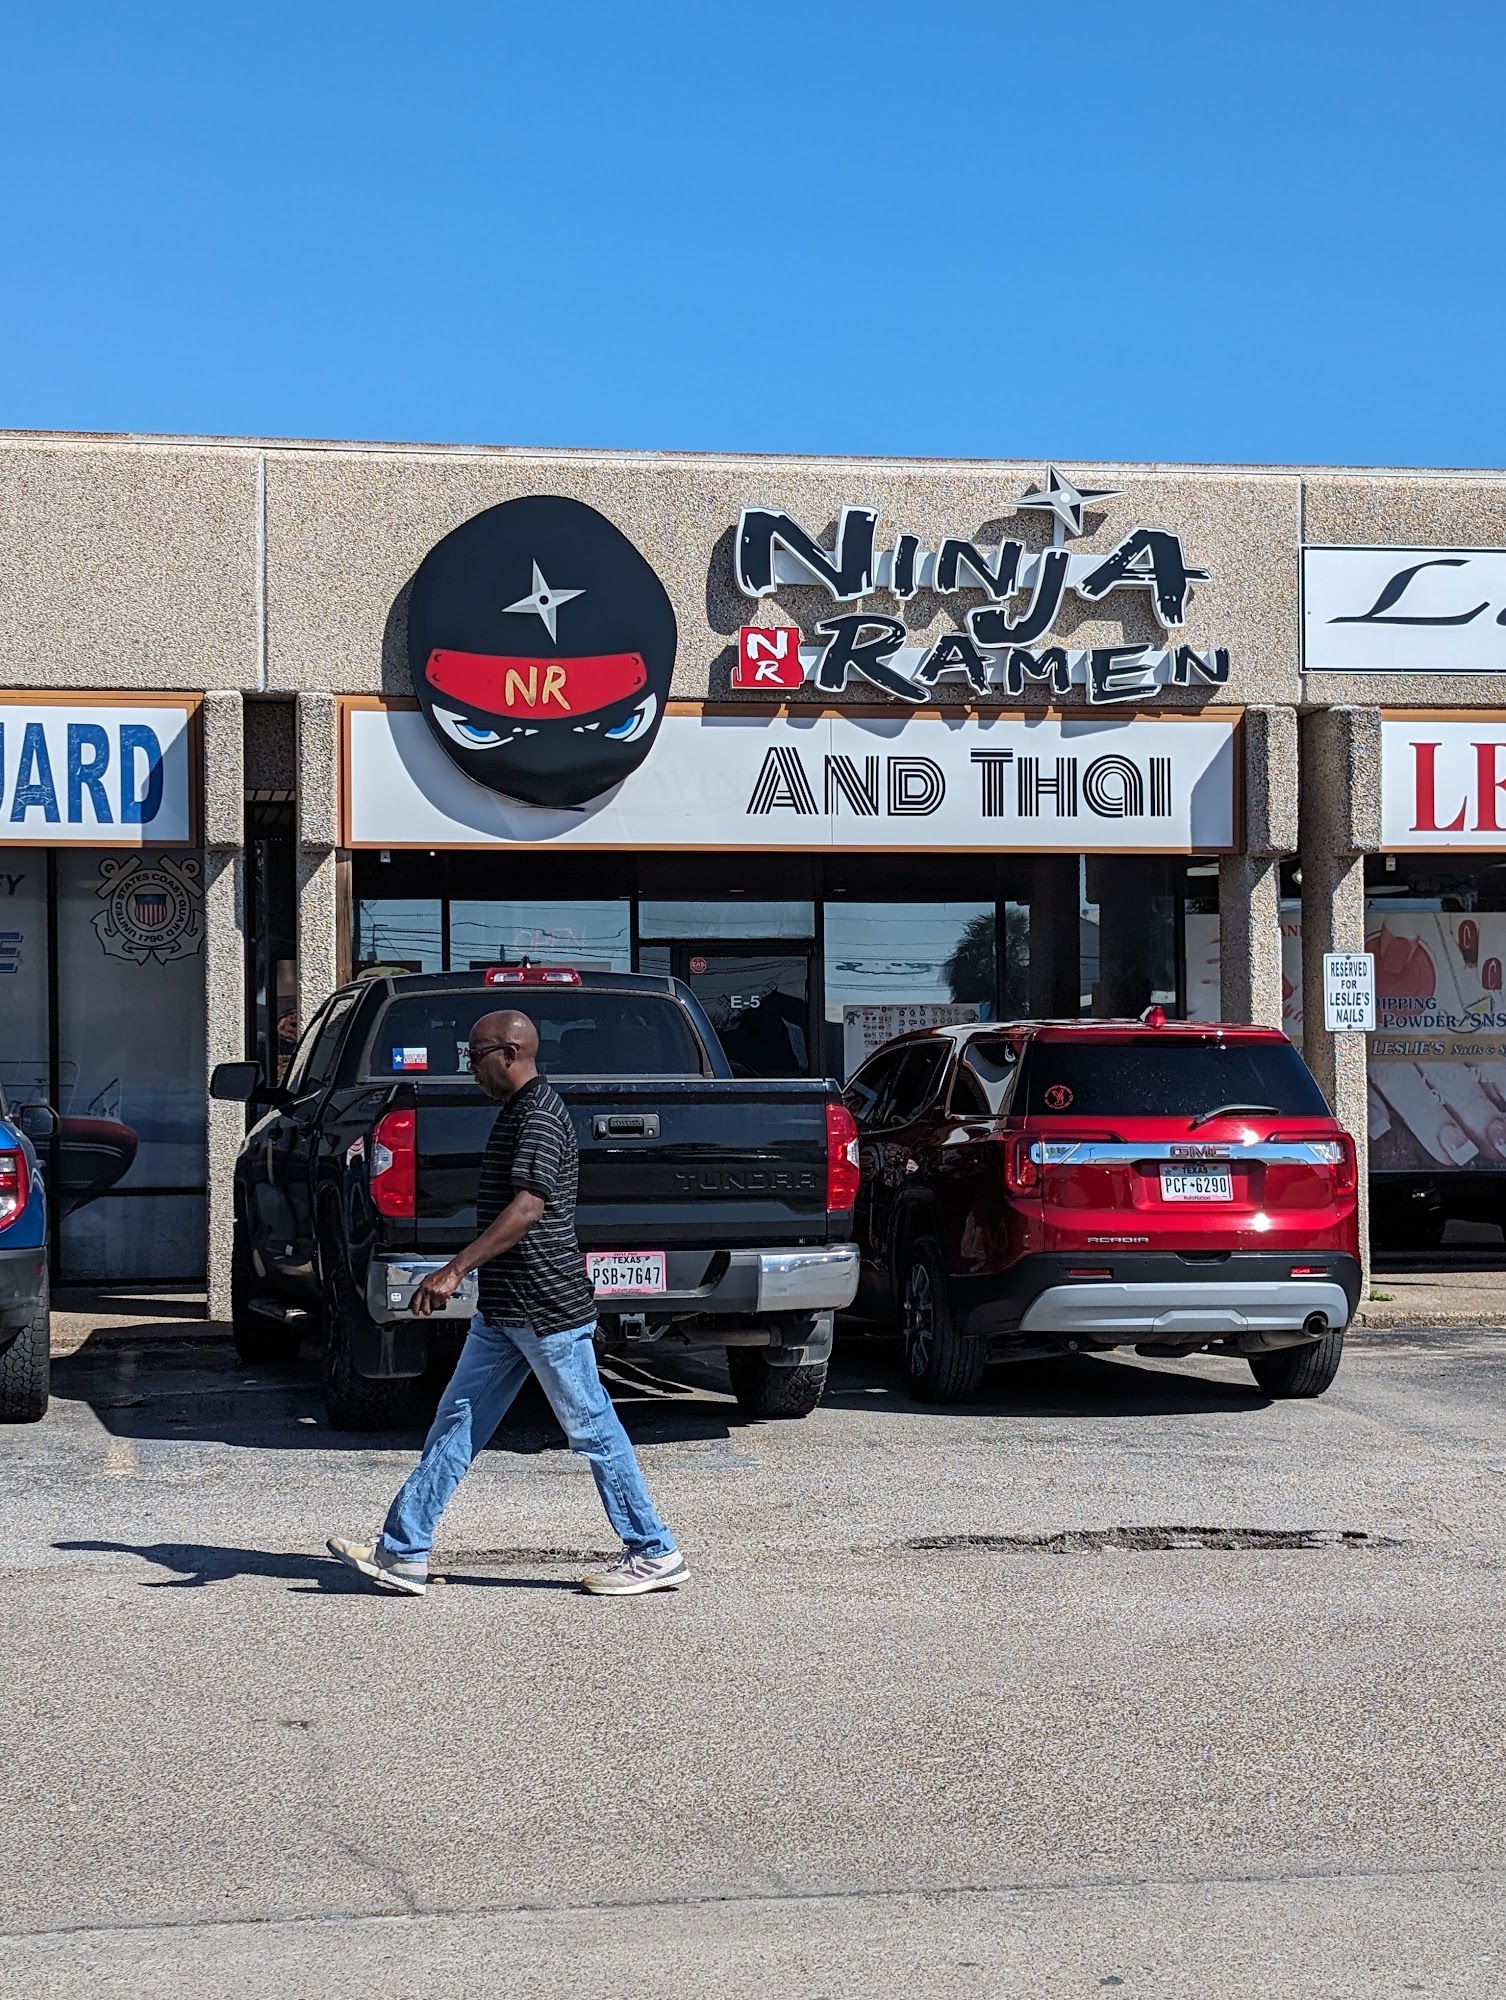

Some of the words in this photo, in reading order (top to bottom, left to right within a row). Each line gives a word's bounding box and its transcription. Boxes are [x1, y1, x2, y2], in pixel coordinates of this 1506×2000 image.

[735, 505, 1212, 648] NINJA
[1325, 559, 1506, 626] L
[814, 612, 1231, 704] RAMEN
[505, 665, 571, 711] NR
[0, 722, 164, 824] ARD
[746, 746, 946, 817] AND
[117, 873, 150, 901] STATES
[151, 873, 185, 899] COAST
[115, 901, 137, 938] UNITED
[165, 899, 187, 937] GUARD
[138, 933, 164, 943] 1790
[1330, 961, 1368, 978] RESERVED
[1341, 979, 1358, 990] FOR
[730, 995, 761, 1009] E-5
[1329, 991, 1371, 1007] LESLIE'S
[1336, 1008, 1365, 1024] NAILS
[1170, 1145, 1231, 1158] GMC
[676, 1171, 816, 1190] TUNDRA
[612, 1256, 641, 1264] TEXAS
